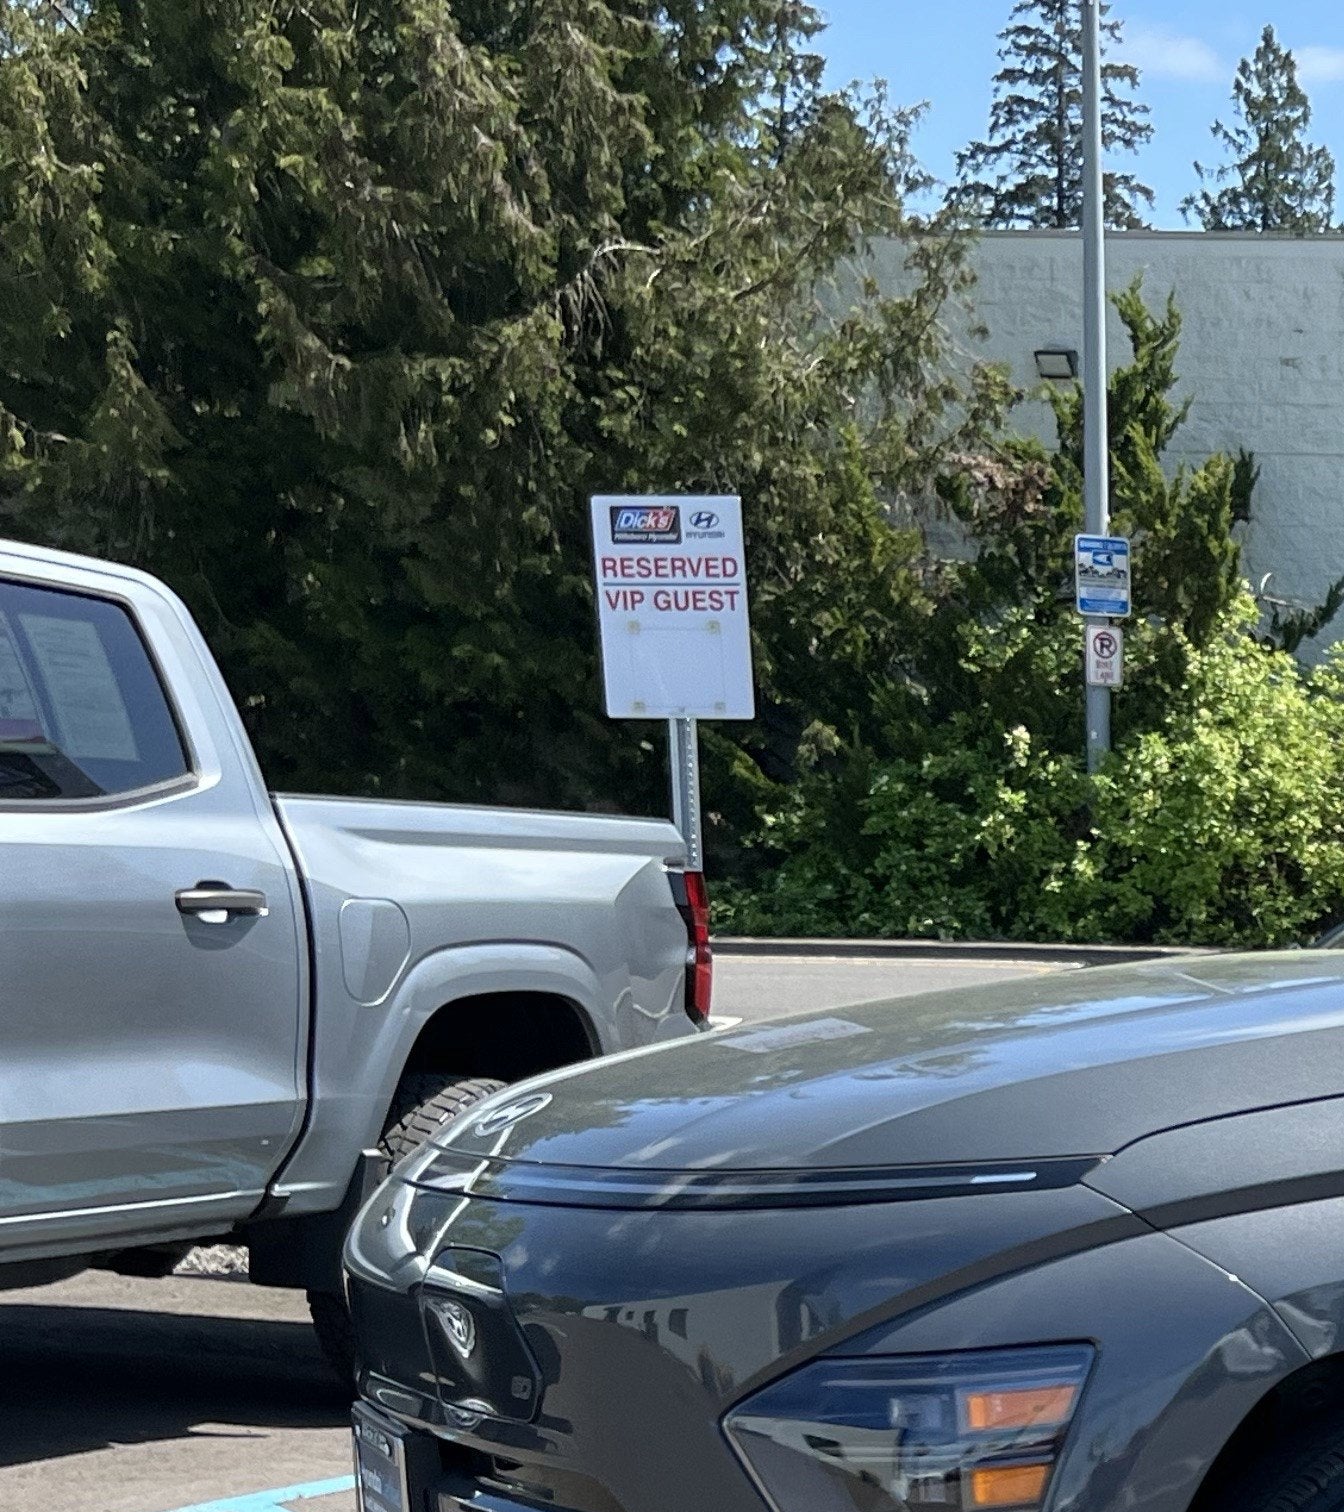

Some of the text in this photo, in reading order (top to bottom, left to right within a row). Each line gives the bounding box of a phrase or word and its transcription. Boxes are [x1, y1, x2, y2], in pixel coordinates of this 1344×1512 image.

[601, 556, 739, 579] RESERVED
[605, 589, 741, 612] VIP GUEST
